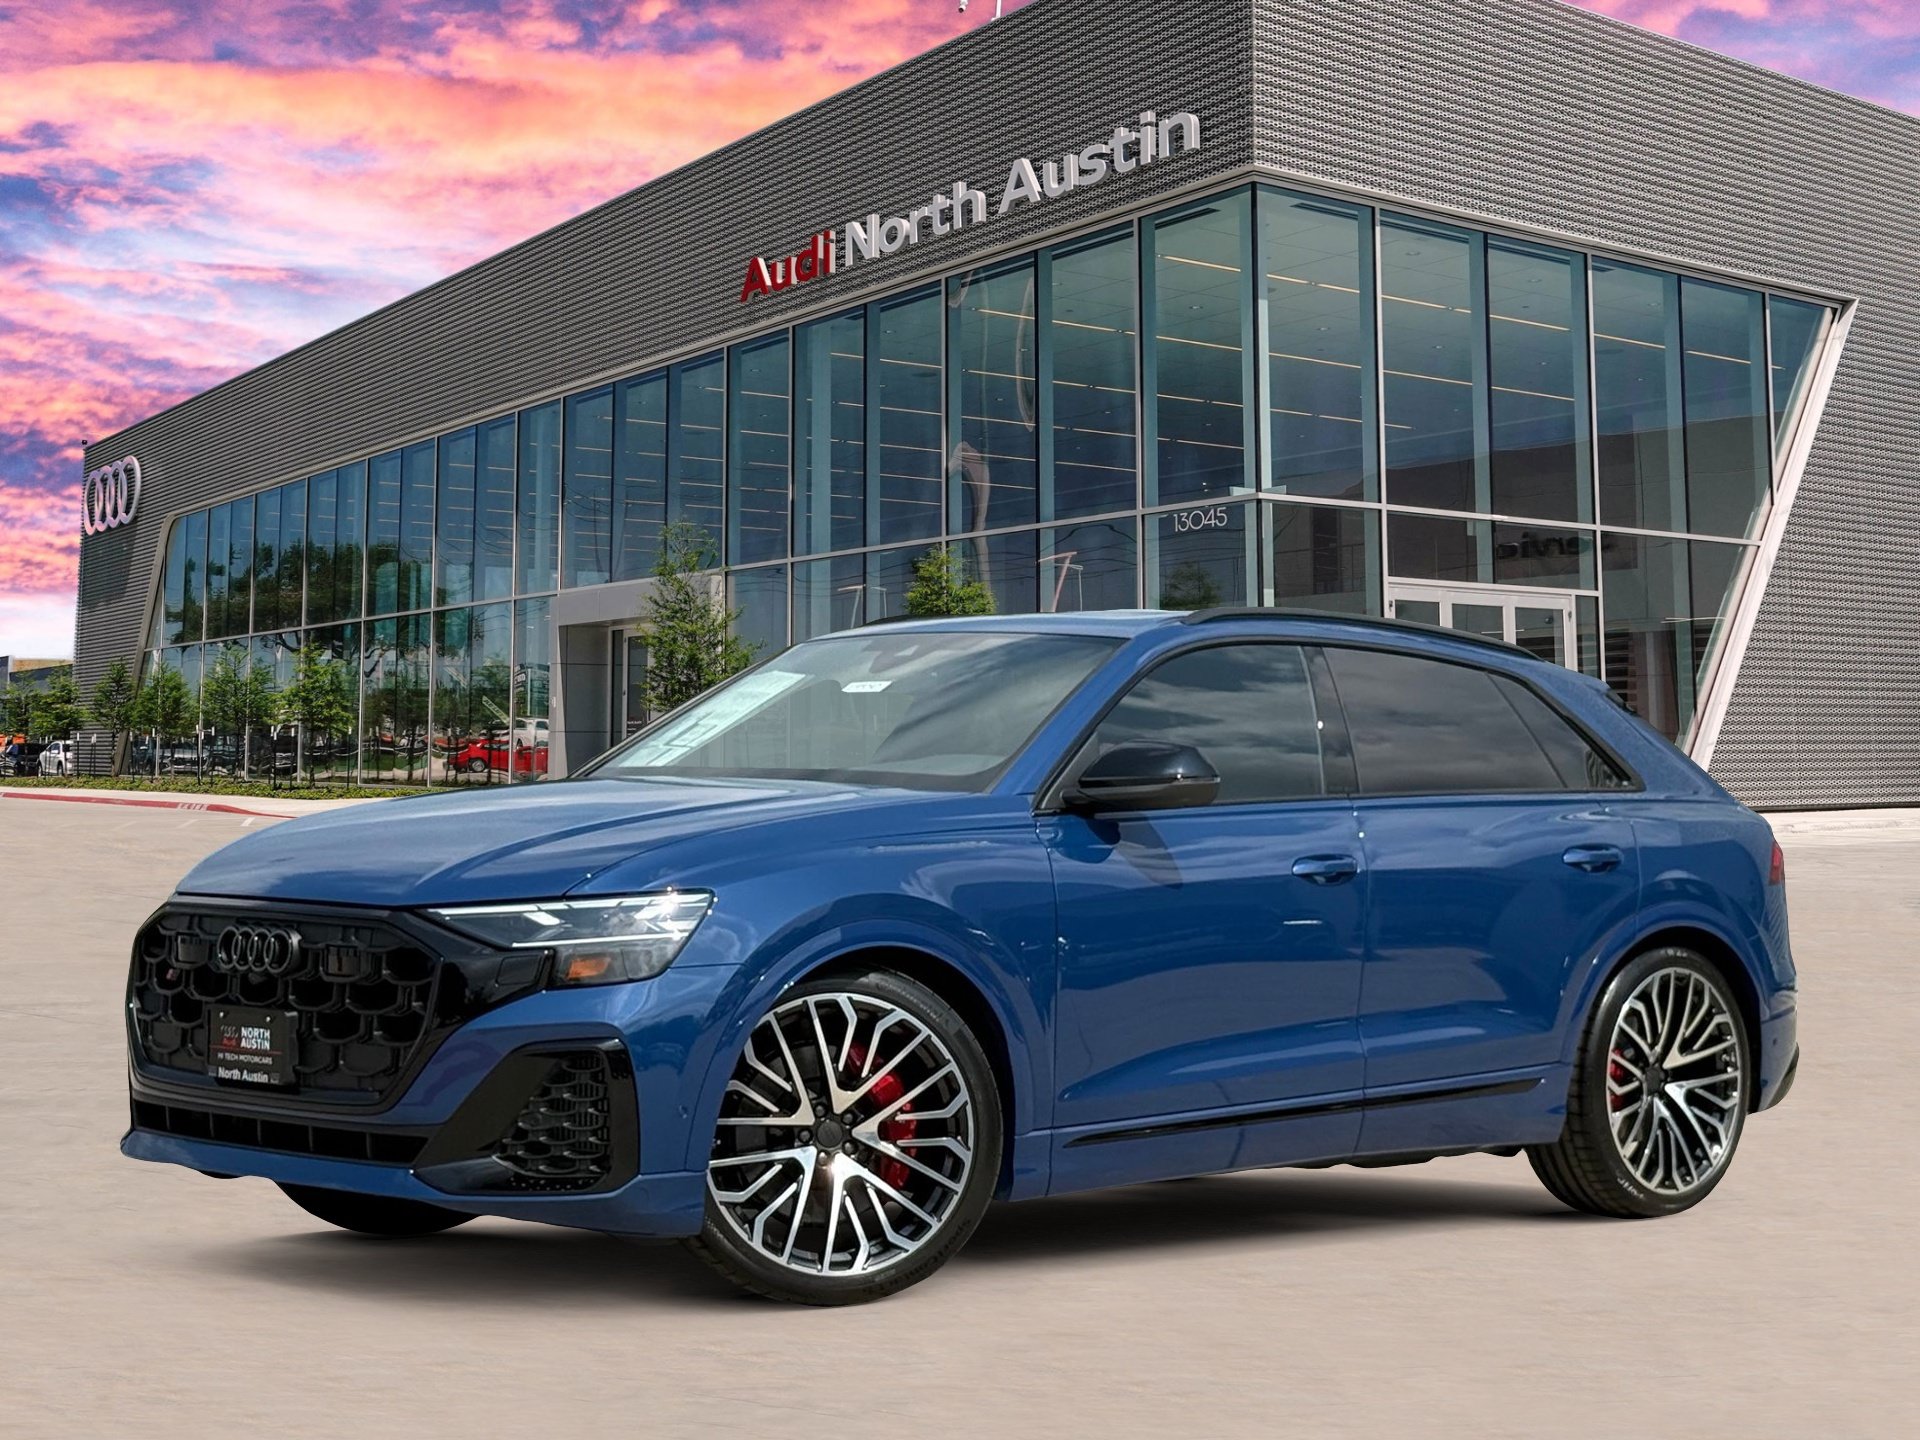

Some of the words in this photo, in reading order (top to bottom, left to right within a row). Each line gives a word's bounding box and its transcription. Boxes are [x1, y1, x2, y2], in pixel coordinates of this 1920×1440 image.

[740, 229, 836, 302] Audi
[845, 181, 986, 267] North
[1000, 111, 1200, 213] Austin
[1173, 507, 1227, 532] 13045
[241, 1026, 270, 1040] NORTH
[240, 1037, 270, 1050] AUSTIN
[218, 1066, 240, 1080] North
[242, 1069, 268, 1083] Austin
